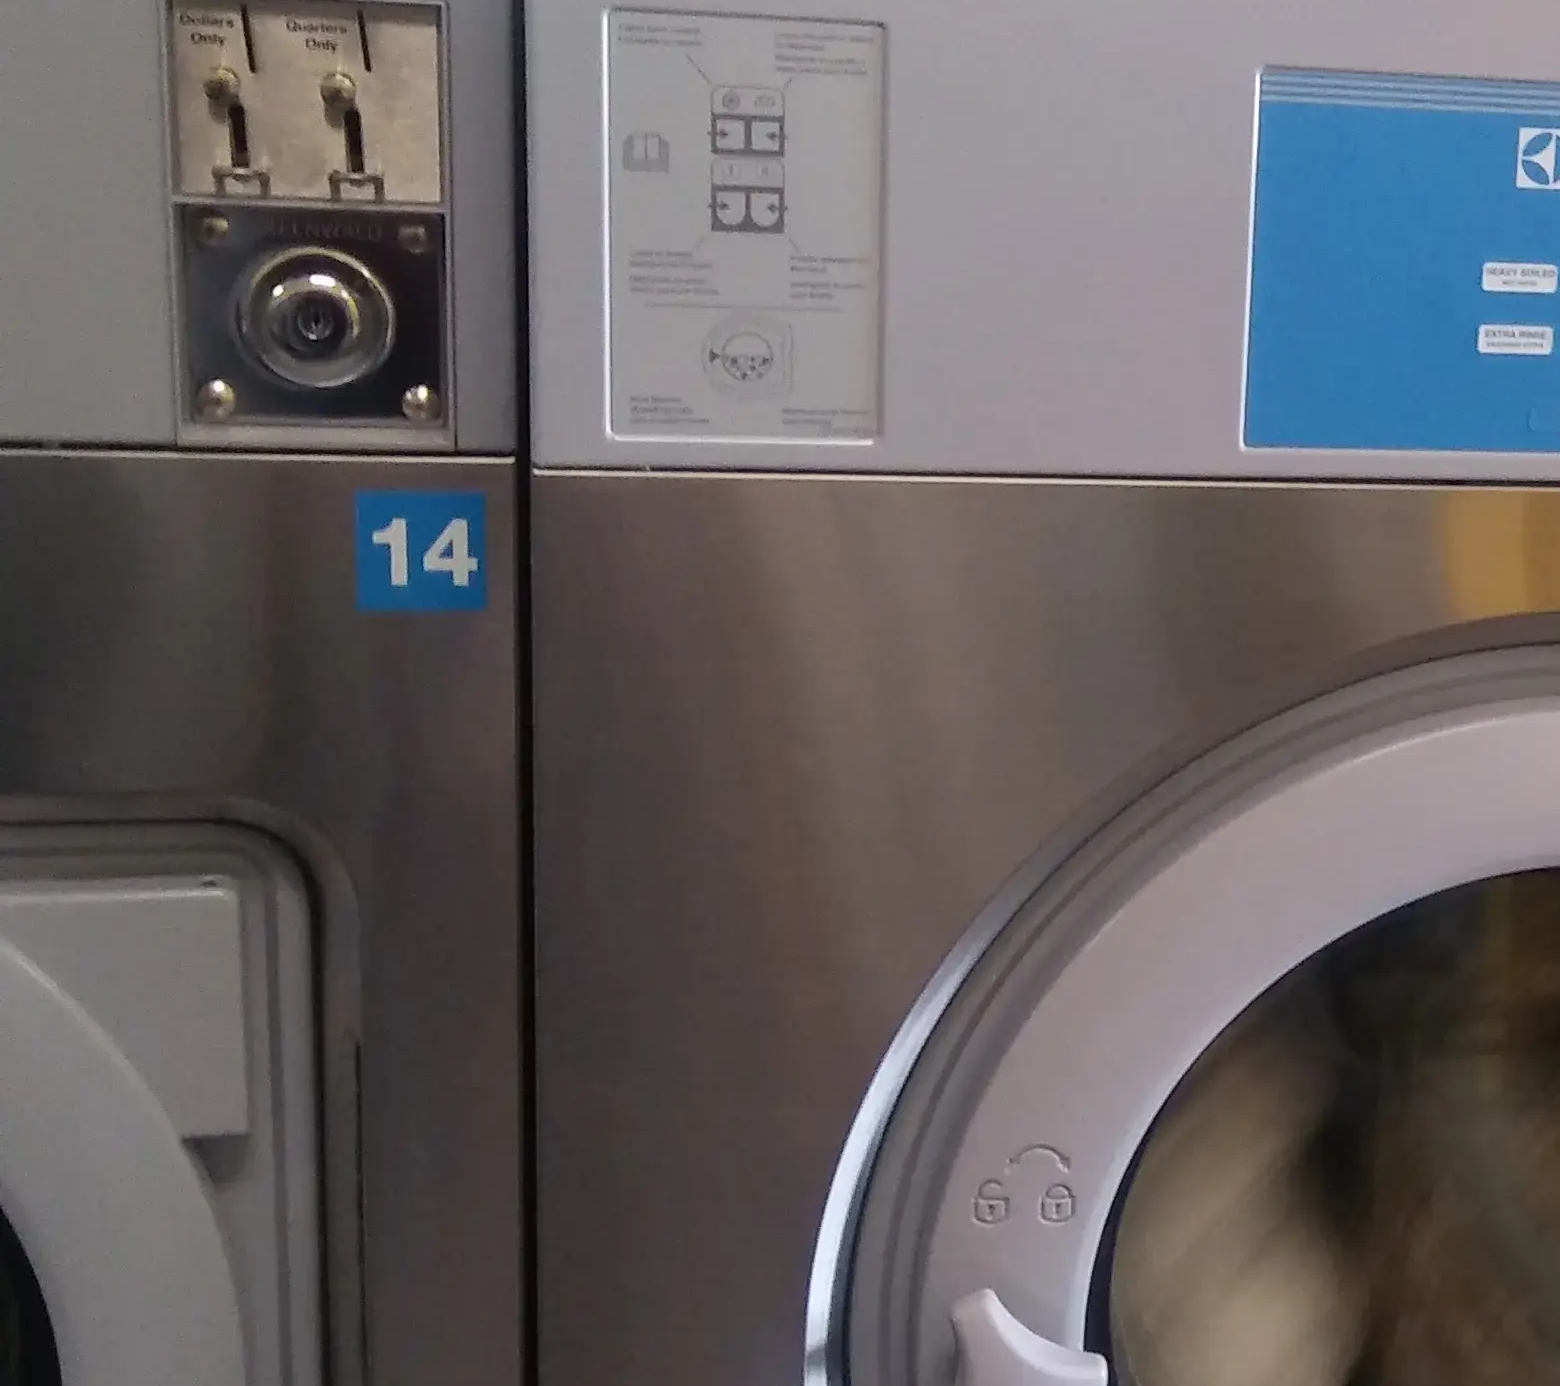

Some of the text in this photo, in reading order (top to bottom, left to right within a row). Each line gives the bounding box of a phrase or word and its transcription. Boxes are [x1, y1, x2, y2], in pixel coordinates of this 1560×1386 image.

[179, 12, 235, 28] Dollars
[285, 19, 347, 34] Quarters
[190, 32, 226, 47] Only
[305, 38, 338, 53] Only
[372, 517, 479, 587] 14
